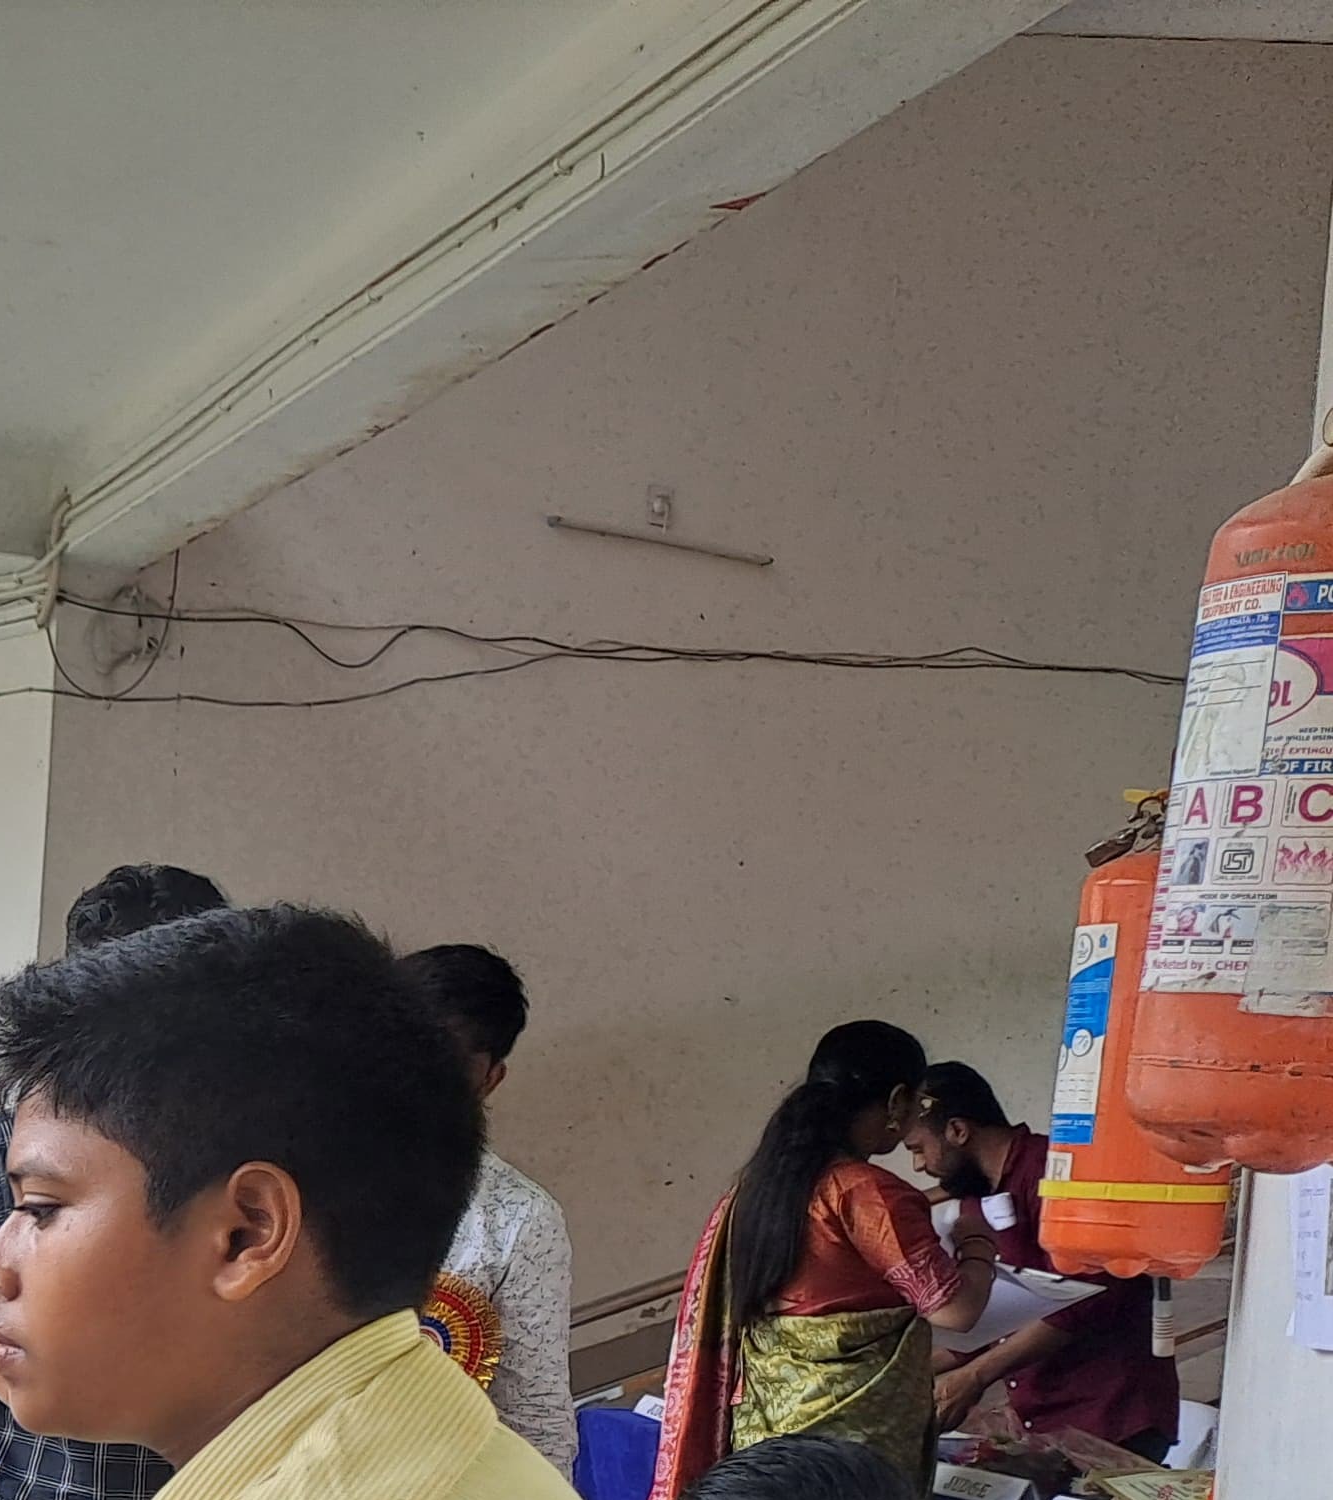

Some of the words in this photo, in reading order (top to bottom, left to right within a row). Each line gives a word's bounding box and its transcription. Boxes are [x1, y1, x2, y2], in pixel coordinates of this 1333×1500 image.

[1185, 787, 1209, 826] A
[1229, 785, 1264, 823] B
[1298, 783, 1333, 822] C
[943, 1475, 993, 1498] JUDGE
